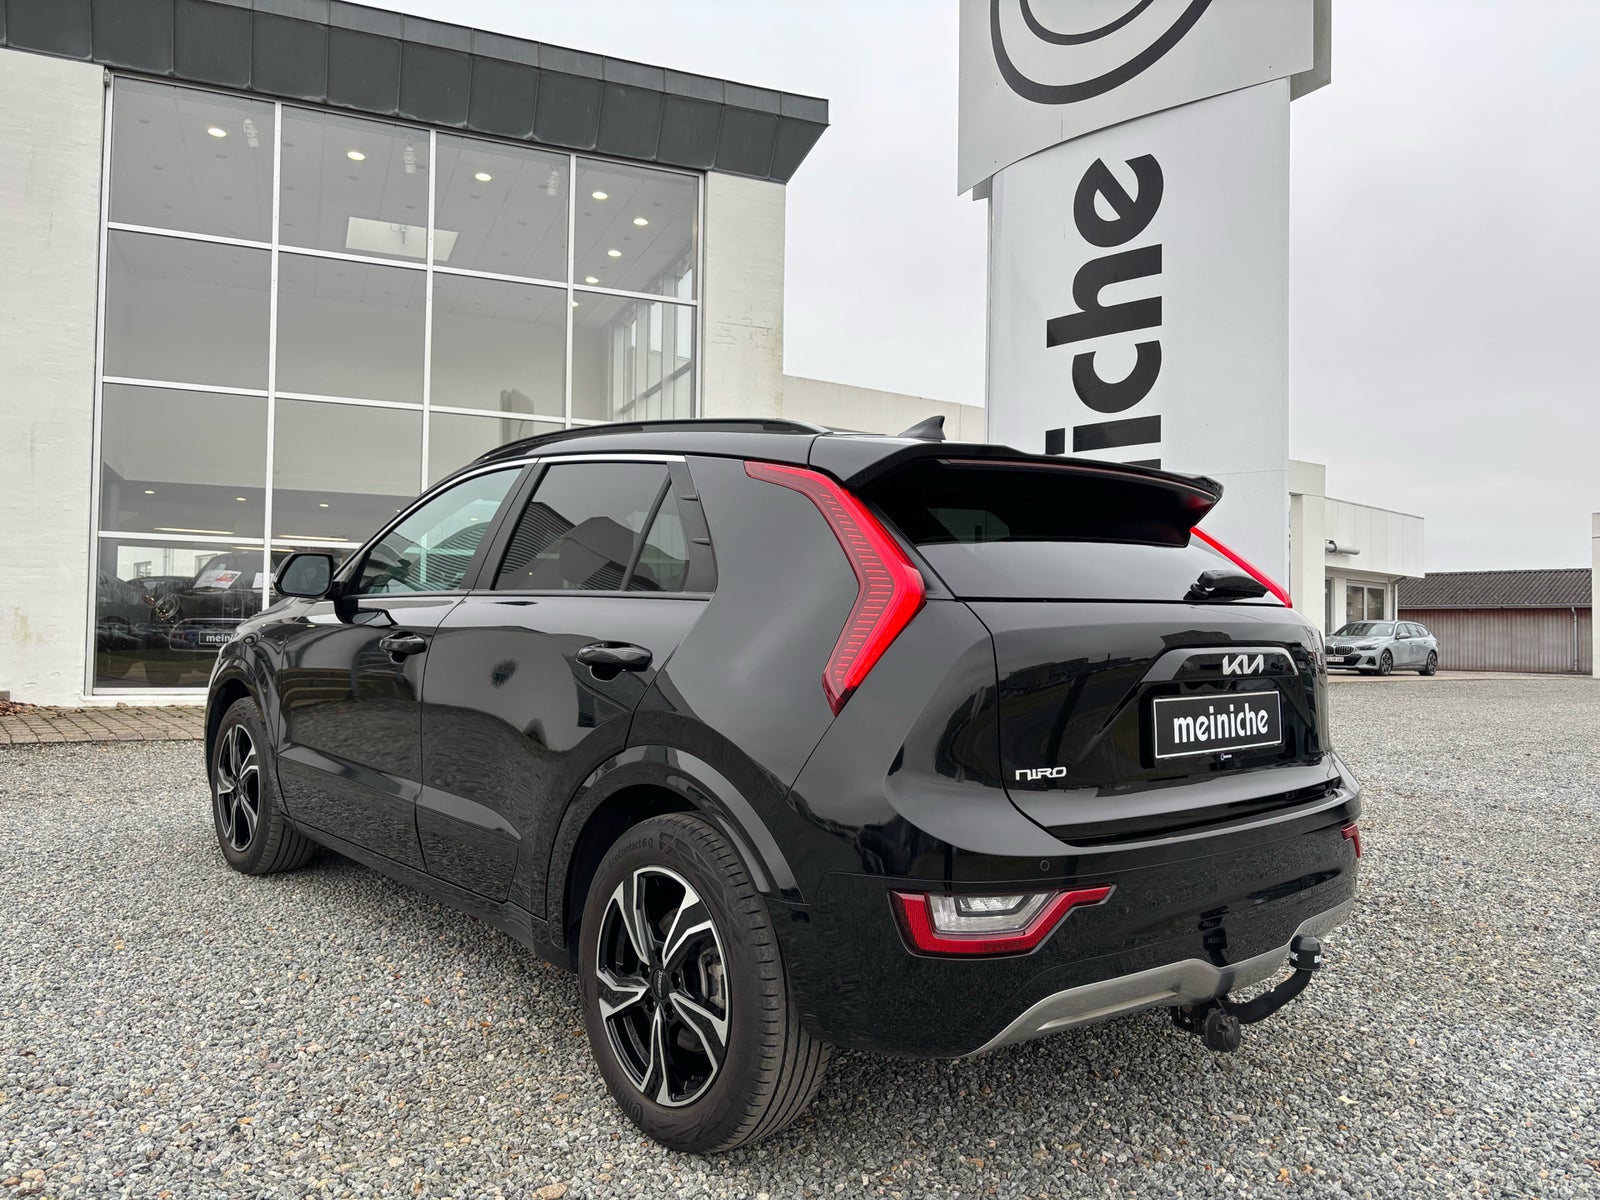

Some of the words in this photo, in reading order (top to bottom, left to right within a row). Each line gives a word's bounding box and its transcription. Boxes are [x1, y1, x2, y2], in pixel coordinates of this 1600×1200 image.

[1045, 153, 1164, 470] iche
[1222, 654, 1264, 675] KIA
[1173, 702, 1269, 744] meiniche
[1015, 766, 1067, 781] NIRO
